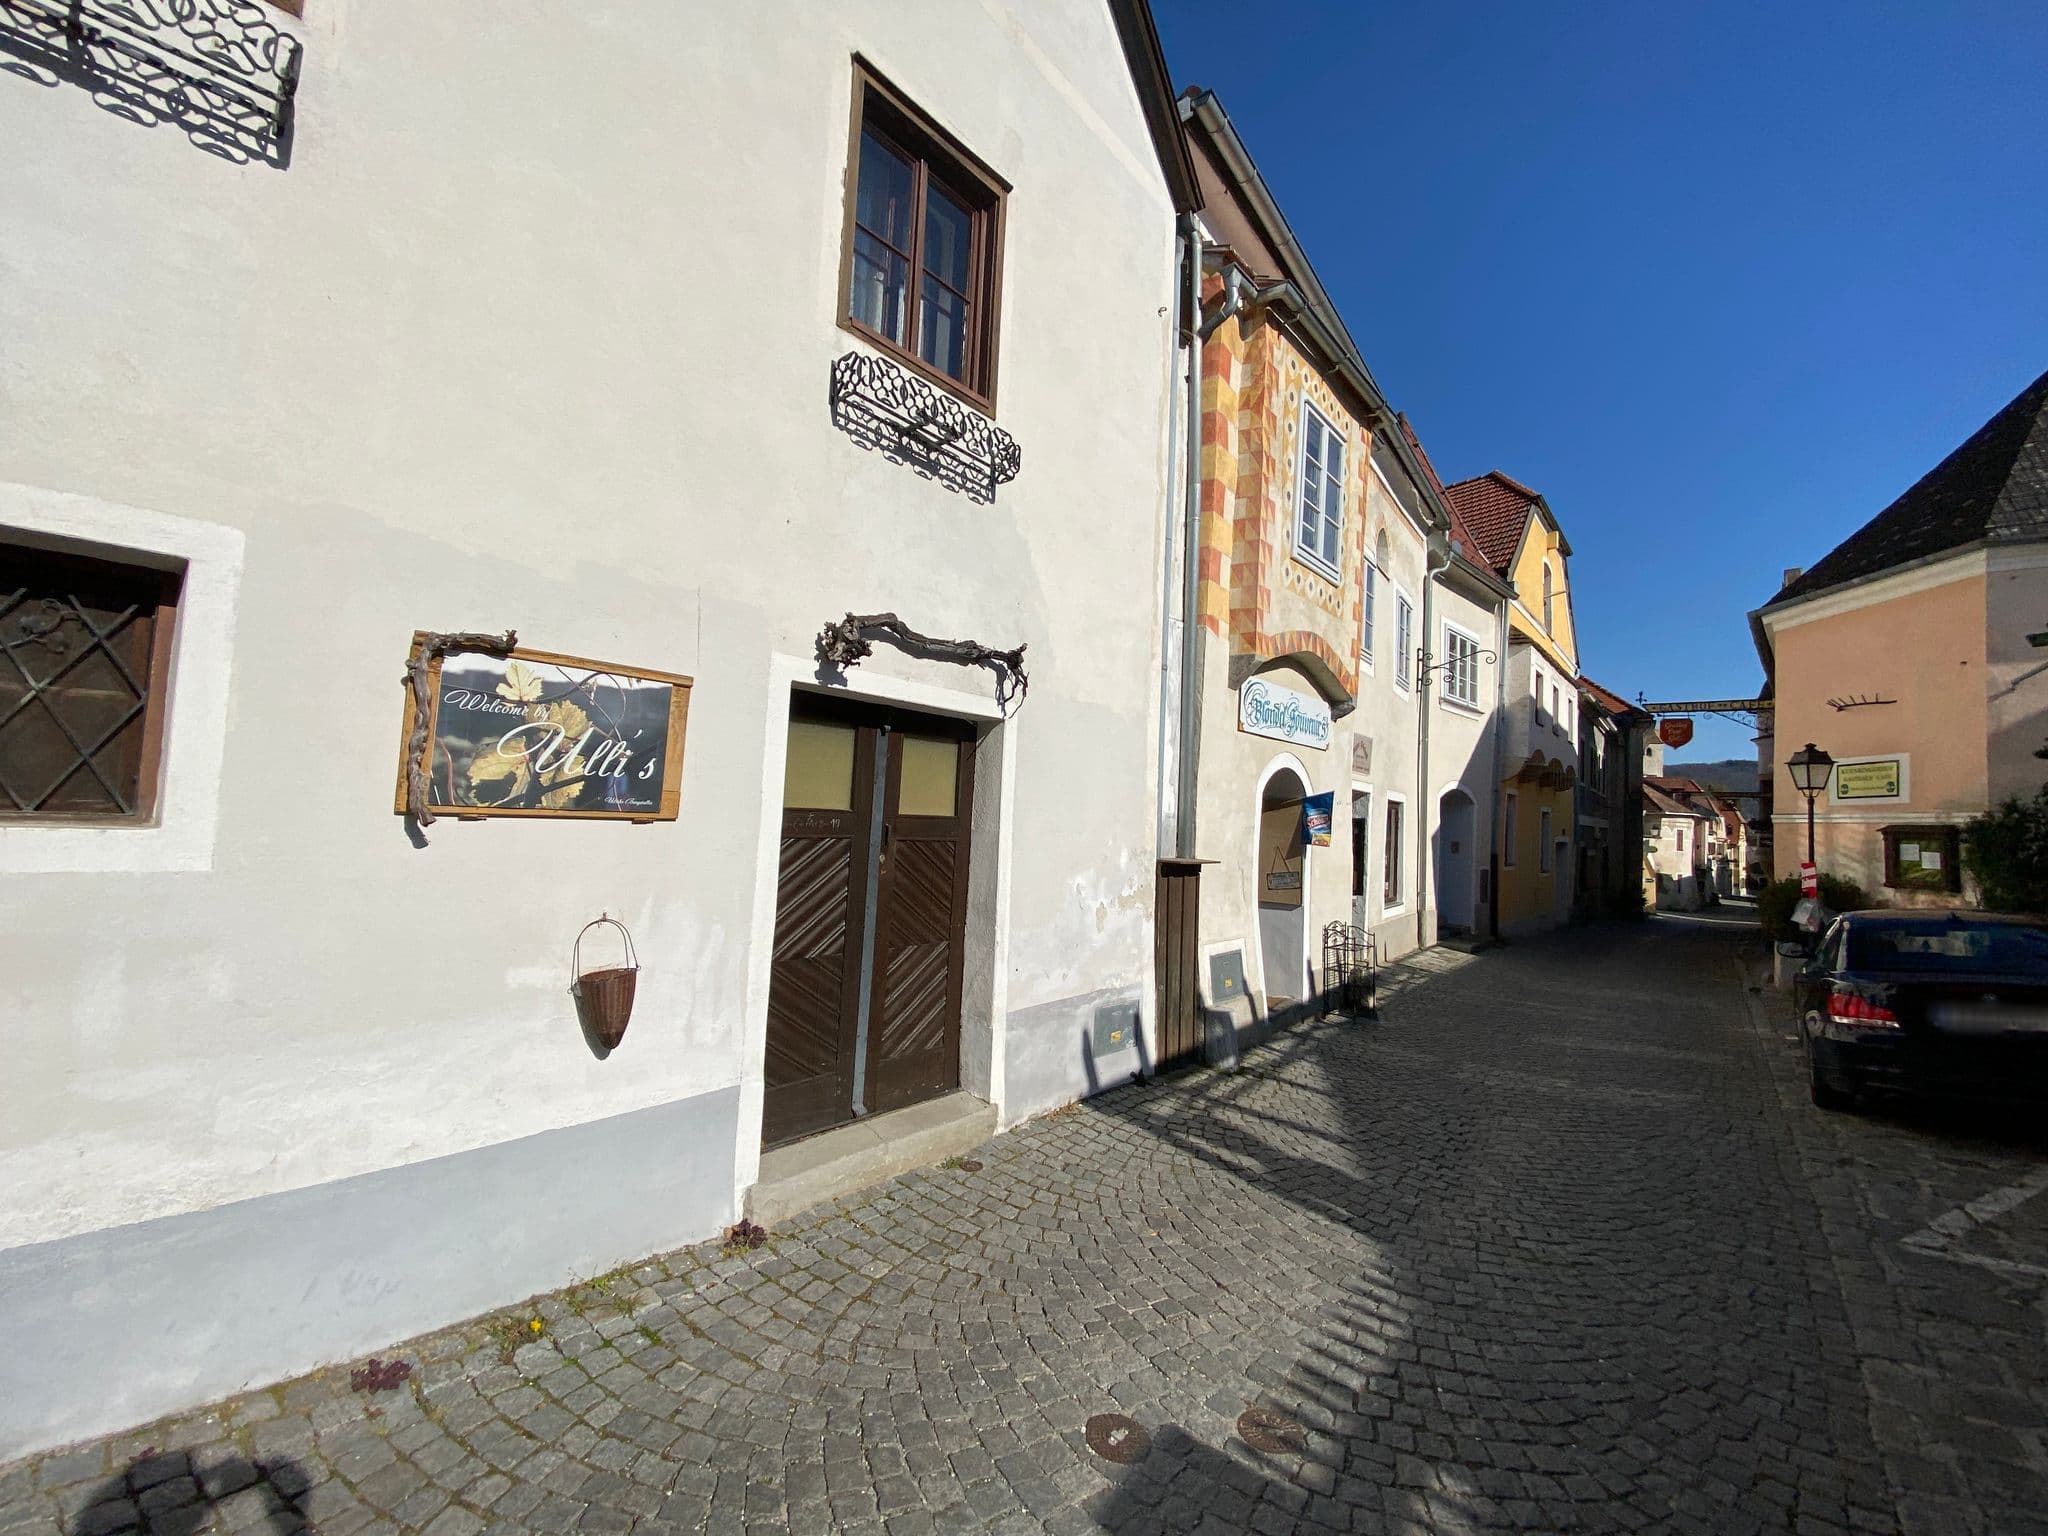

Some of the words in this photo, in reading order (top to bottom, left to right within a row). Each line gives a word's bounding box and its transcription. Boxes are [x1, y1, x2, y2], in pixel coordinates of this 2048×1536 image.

[444, 689, 529, 717] Welcome
[533, 707, 551, 721] by
[496, 721, 656, 780] Ulli's
